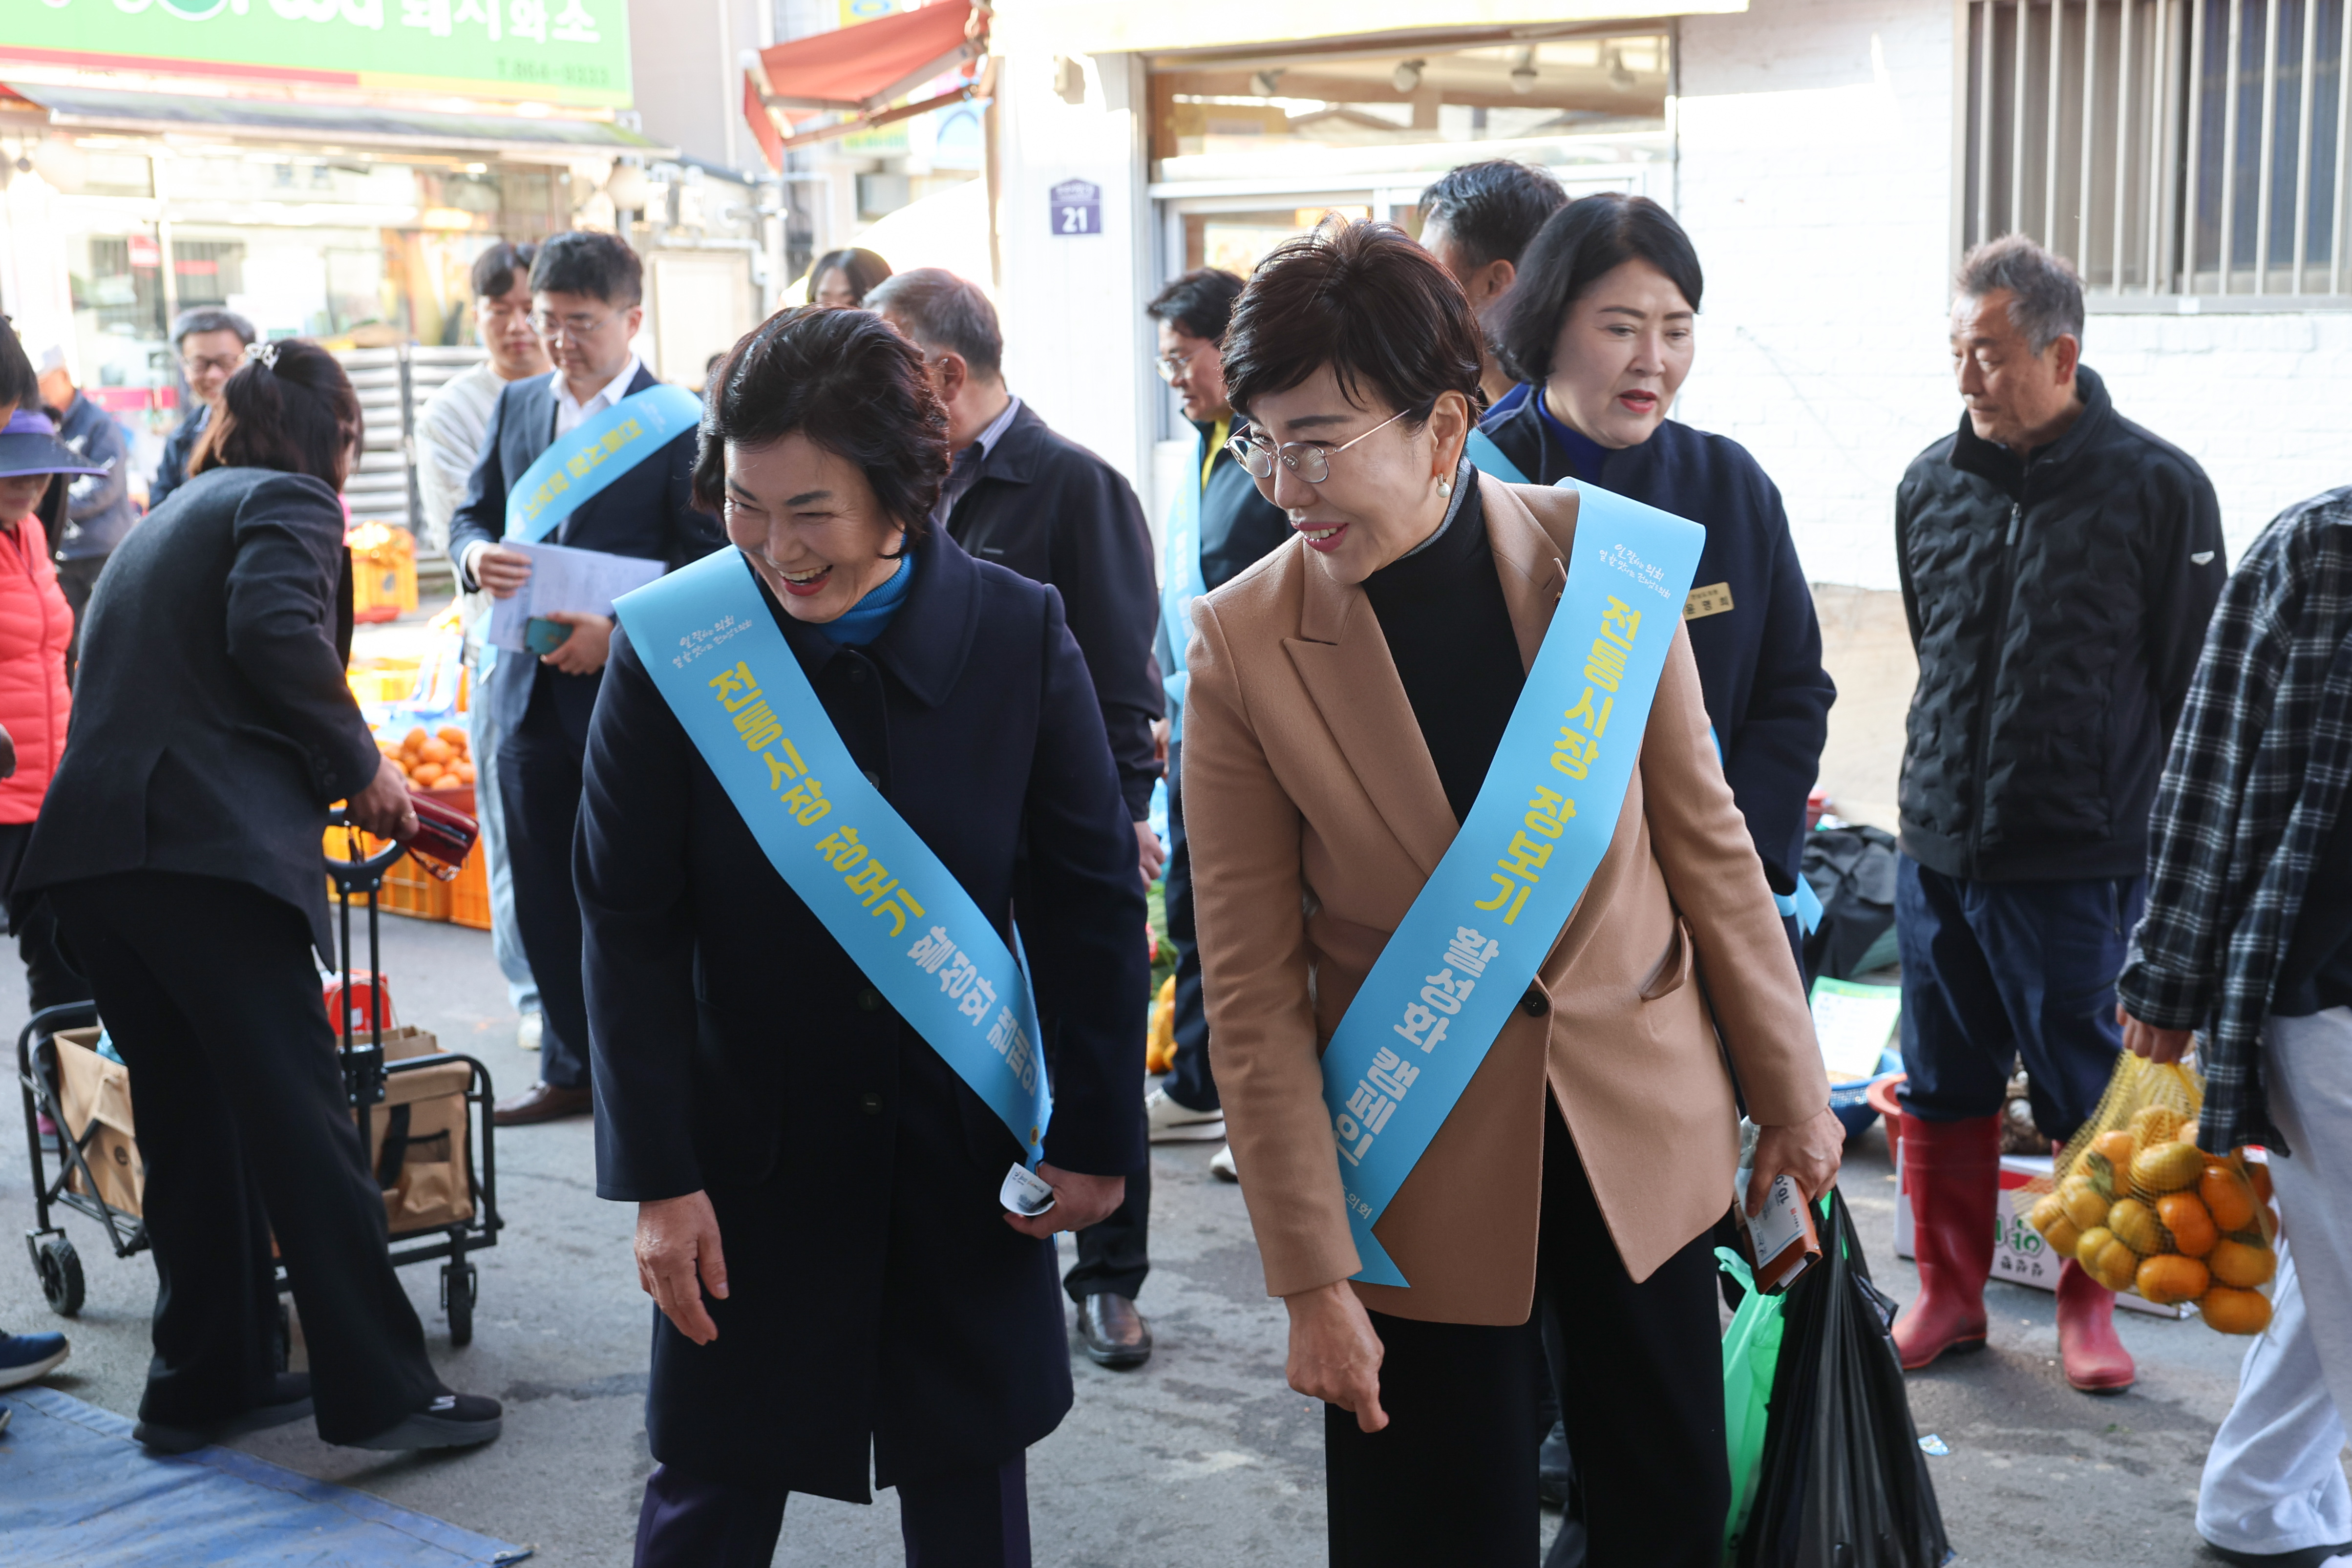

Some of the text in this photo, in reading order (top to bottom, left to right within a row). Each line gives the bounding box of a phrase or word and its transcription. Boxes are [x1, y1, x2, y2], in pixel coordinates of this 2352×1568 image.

[1062, 206, 1087, 233] 21
[1645, 564, 1664, 582] 의회
[709, 661, 1039, 1097] 전통시장 장보기 활성화 캠페인
[1333, 595, 1641, 1166] 전통시장 장보기 활성화 캠페인
